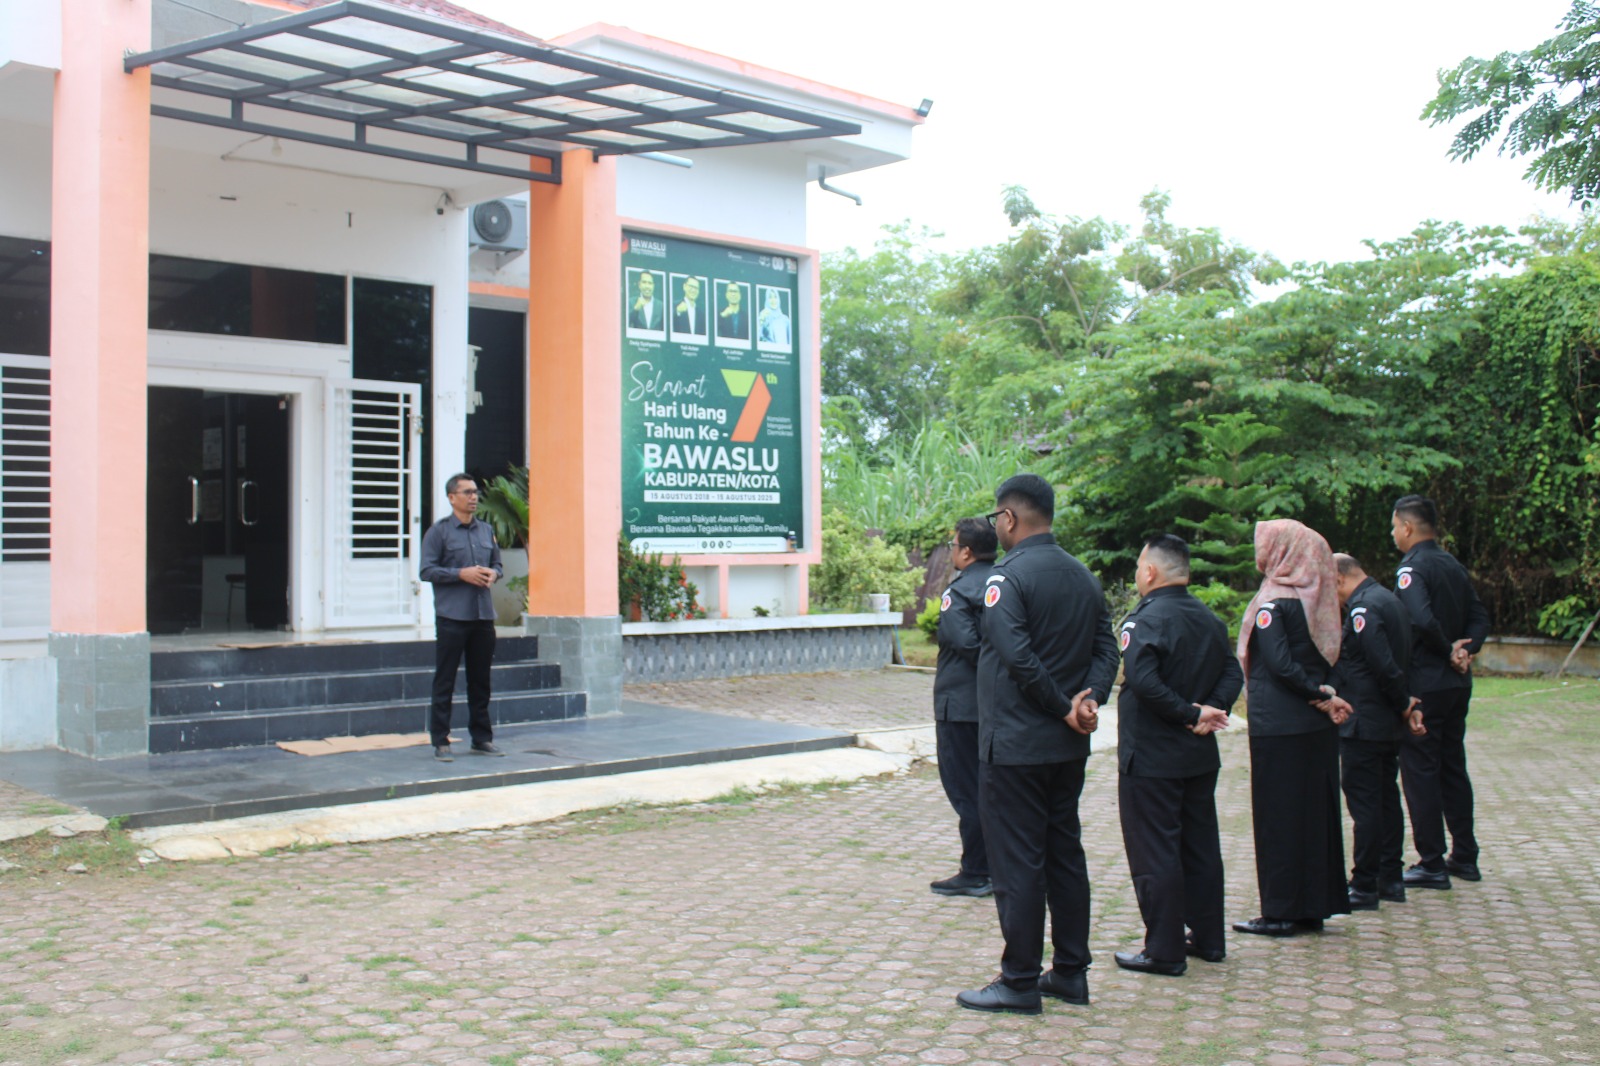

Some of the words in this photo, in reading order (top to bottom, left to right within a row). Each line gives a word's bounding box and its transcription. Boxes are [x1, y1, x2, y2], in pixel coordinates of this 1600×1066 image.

[630, 238, 667, 252] BAWASLU
[628, 360, 708, 401] Selamat
[766, 372, 778, 385] th
[643, 401, 678, 418] Hari
[681, 403, 727, 424] Ulang
[643, 422, 695, 440] Tahun
[698, 425, 719, 441] Ke
[643, 443, 779, 472] BAWASLU
[644, 472, 780, 490] KABUPATEN/KOTA
[657, 514, 691, 523] Bersama
[691, 514, 717, 525] Rakyat
[717, 514, 739, 523] Awasi
[739, 514, 765, 523] Pemilu
[630, 524, 664, 533] Bersama
[665, 524, 697, 533] Bawaslu
[697, 524, 733, 535] Tegakkan
[733, 524, 764, 533] Keadilan
[764, 524, 789, 533] Pemilu
